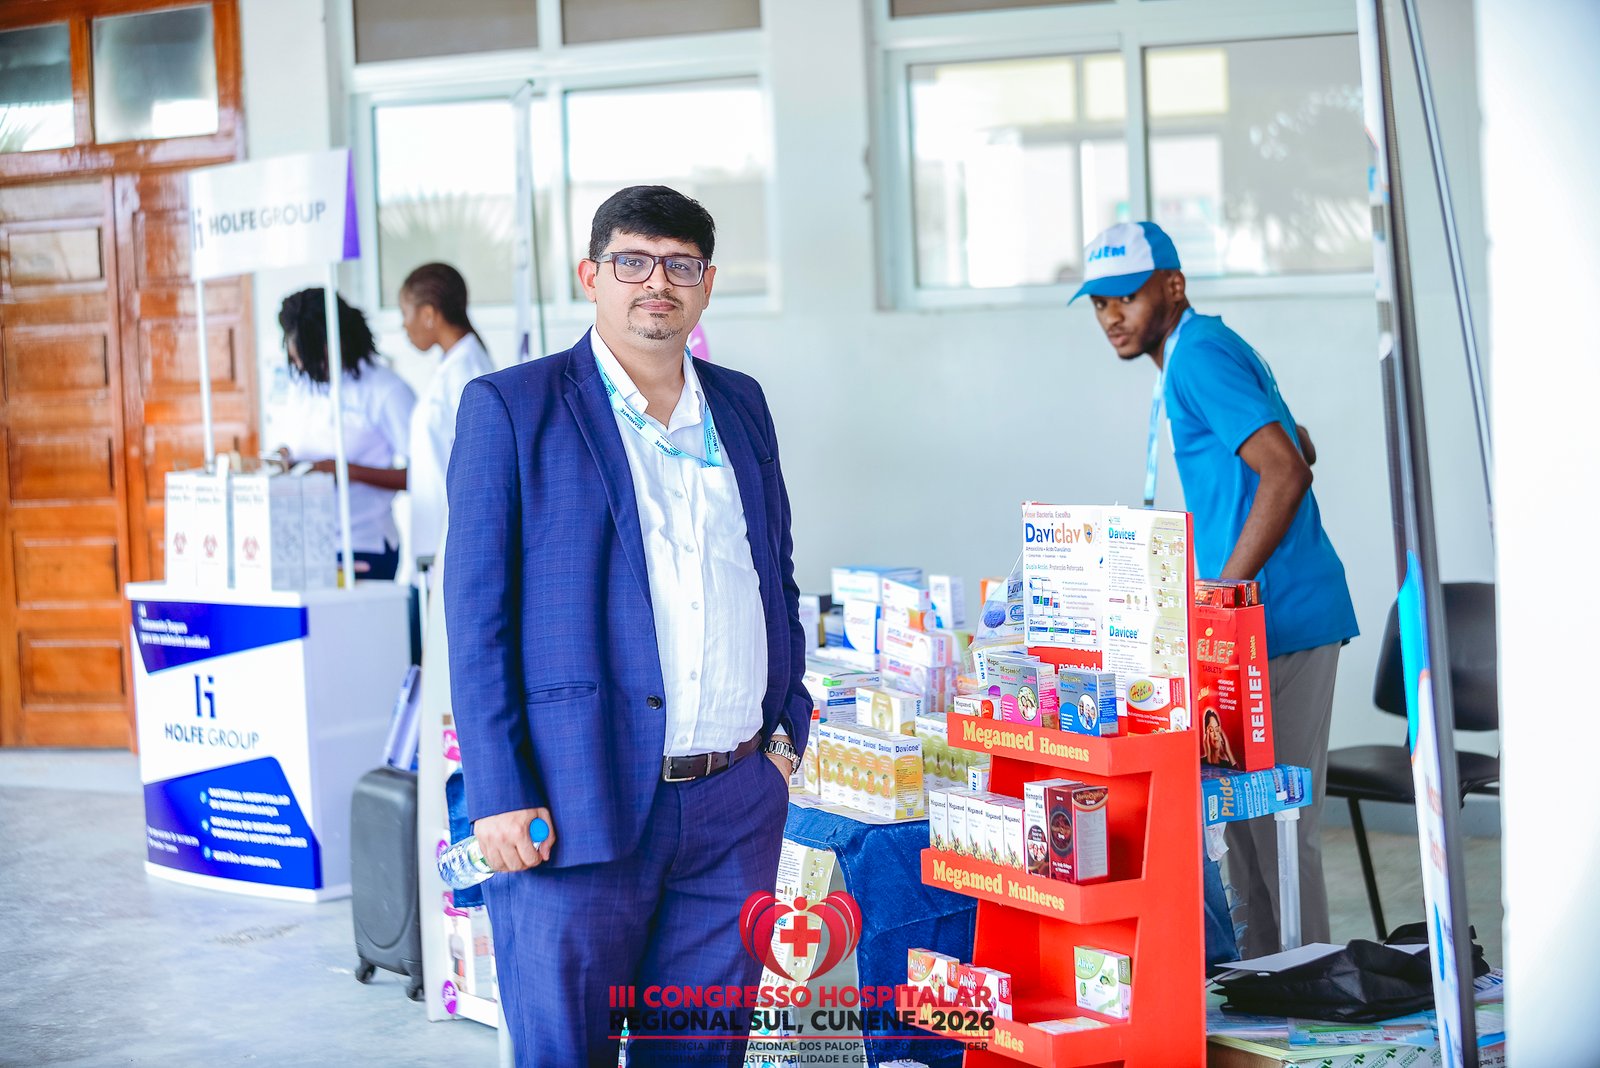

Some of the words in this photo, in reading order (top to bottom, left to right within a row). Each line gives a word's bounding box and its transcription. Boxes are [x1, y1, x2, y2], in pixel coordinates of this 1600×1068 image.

[209, 208, 257, 236] HOLFE
[259, 201, 327, 229] GROUP
[1025, 522, 1081, 544] Daviclav
[1108, 527, 1137, 541] Davicee
[1109, 625, 1139, 639] Davicee
[1197, 638, 1236, 664] ELIEF
[1248, 665, 1266, 743] RELIEF
[164, 722, 204, 745] HOLFE
[208, 728, 260, 750] GROUP
[962, 720, 1035, 750] Megamed
[1039, 737, 1090, 762] Homens
[932, 859, 1004, 895] Megamed
[1007, 880, 1065, 912] Mulheres
